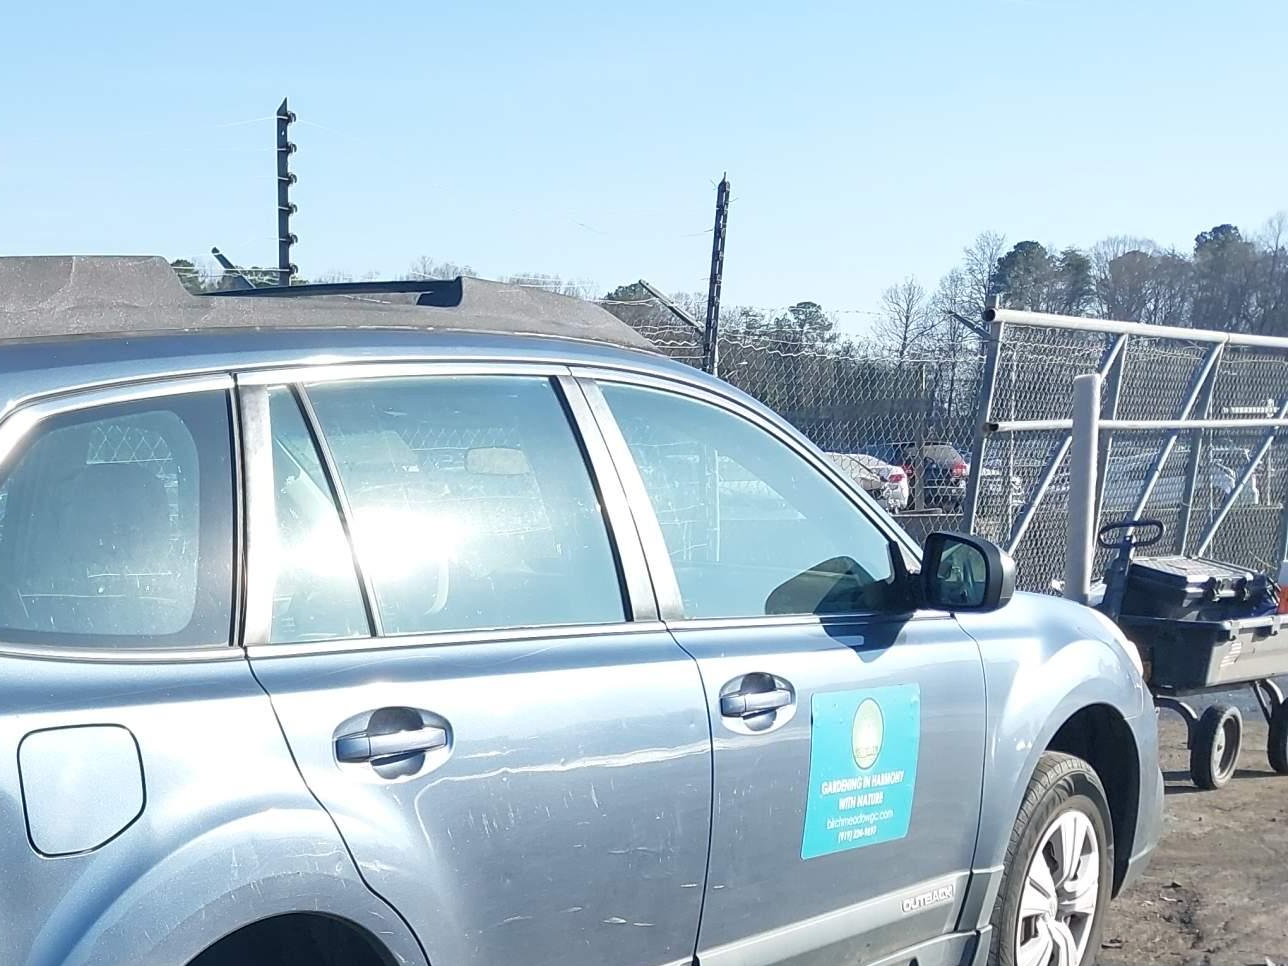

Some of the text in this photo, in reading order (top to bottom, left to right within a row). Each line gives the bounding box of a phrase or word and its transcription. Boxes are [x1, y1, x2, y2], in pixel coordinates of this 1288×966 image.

[821, 776, 863, 795] GARDENING
[863, 775, 872, 788] IN
[901, 884, 953, 913] OUTBACK
